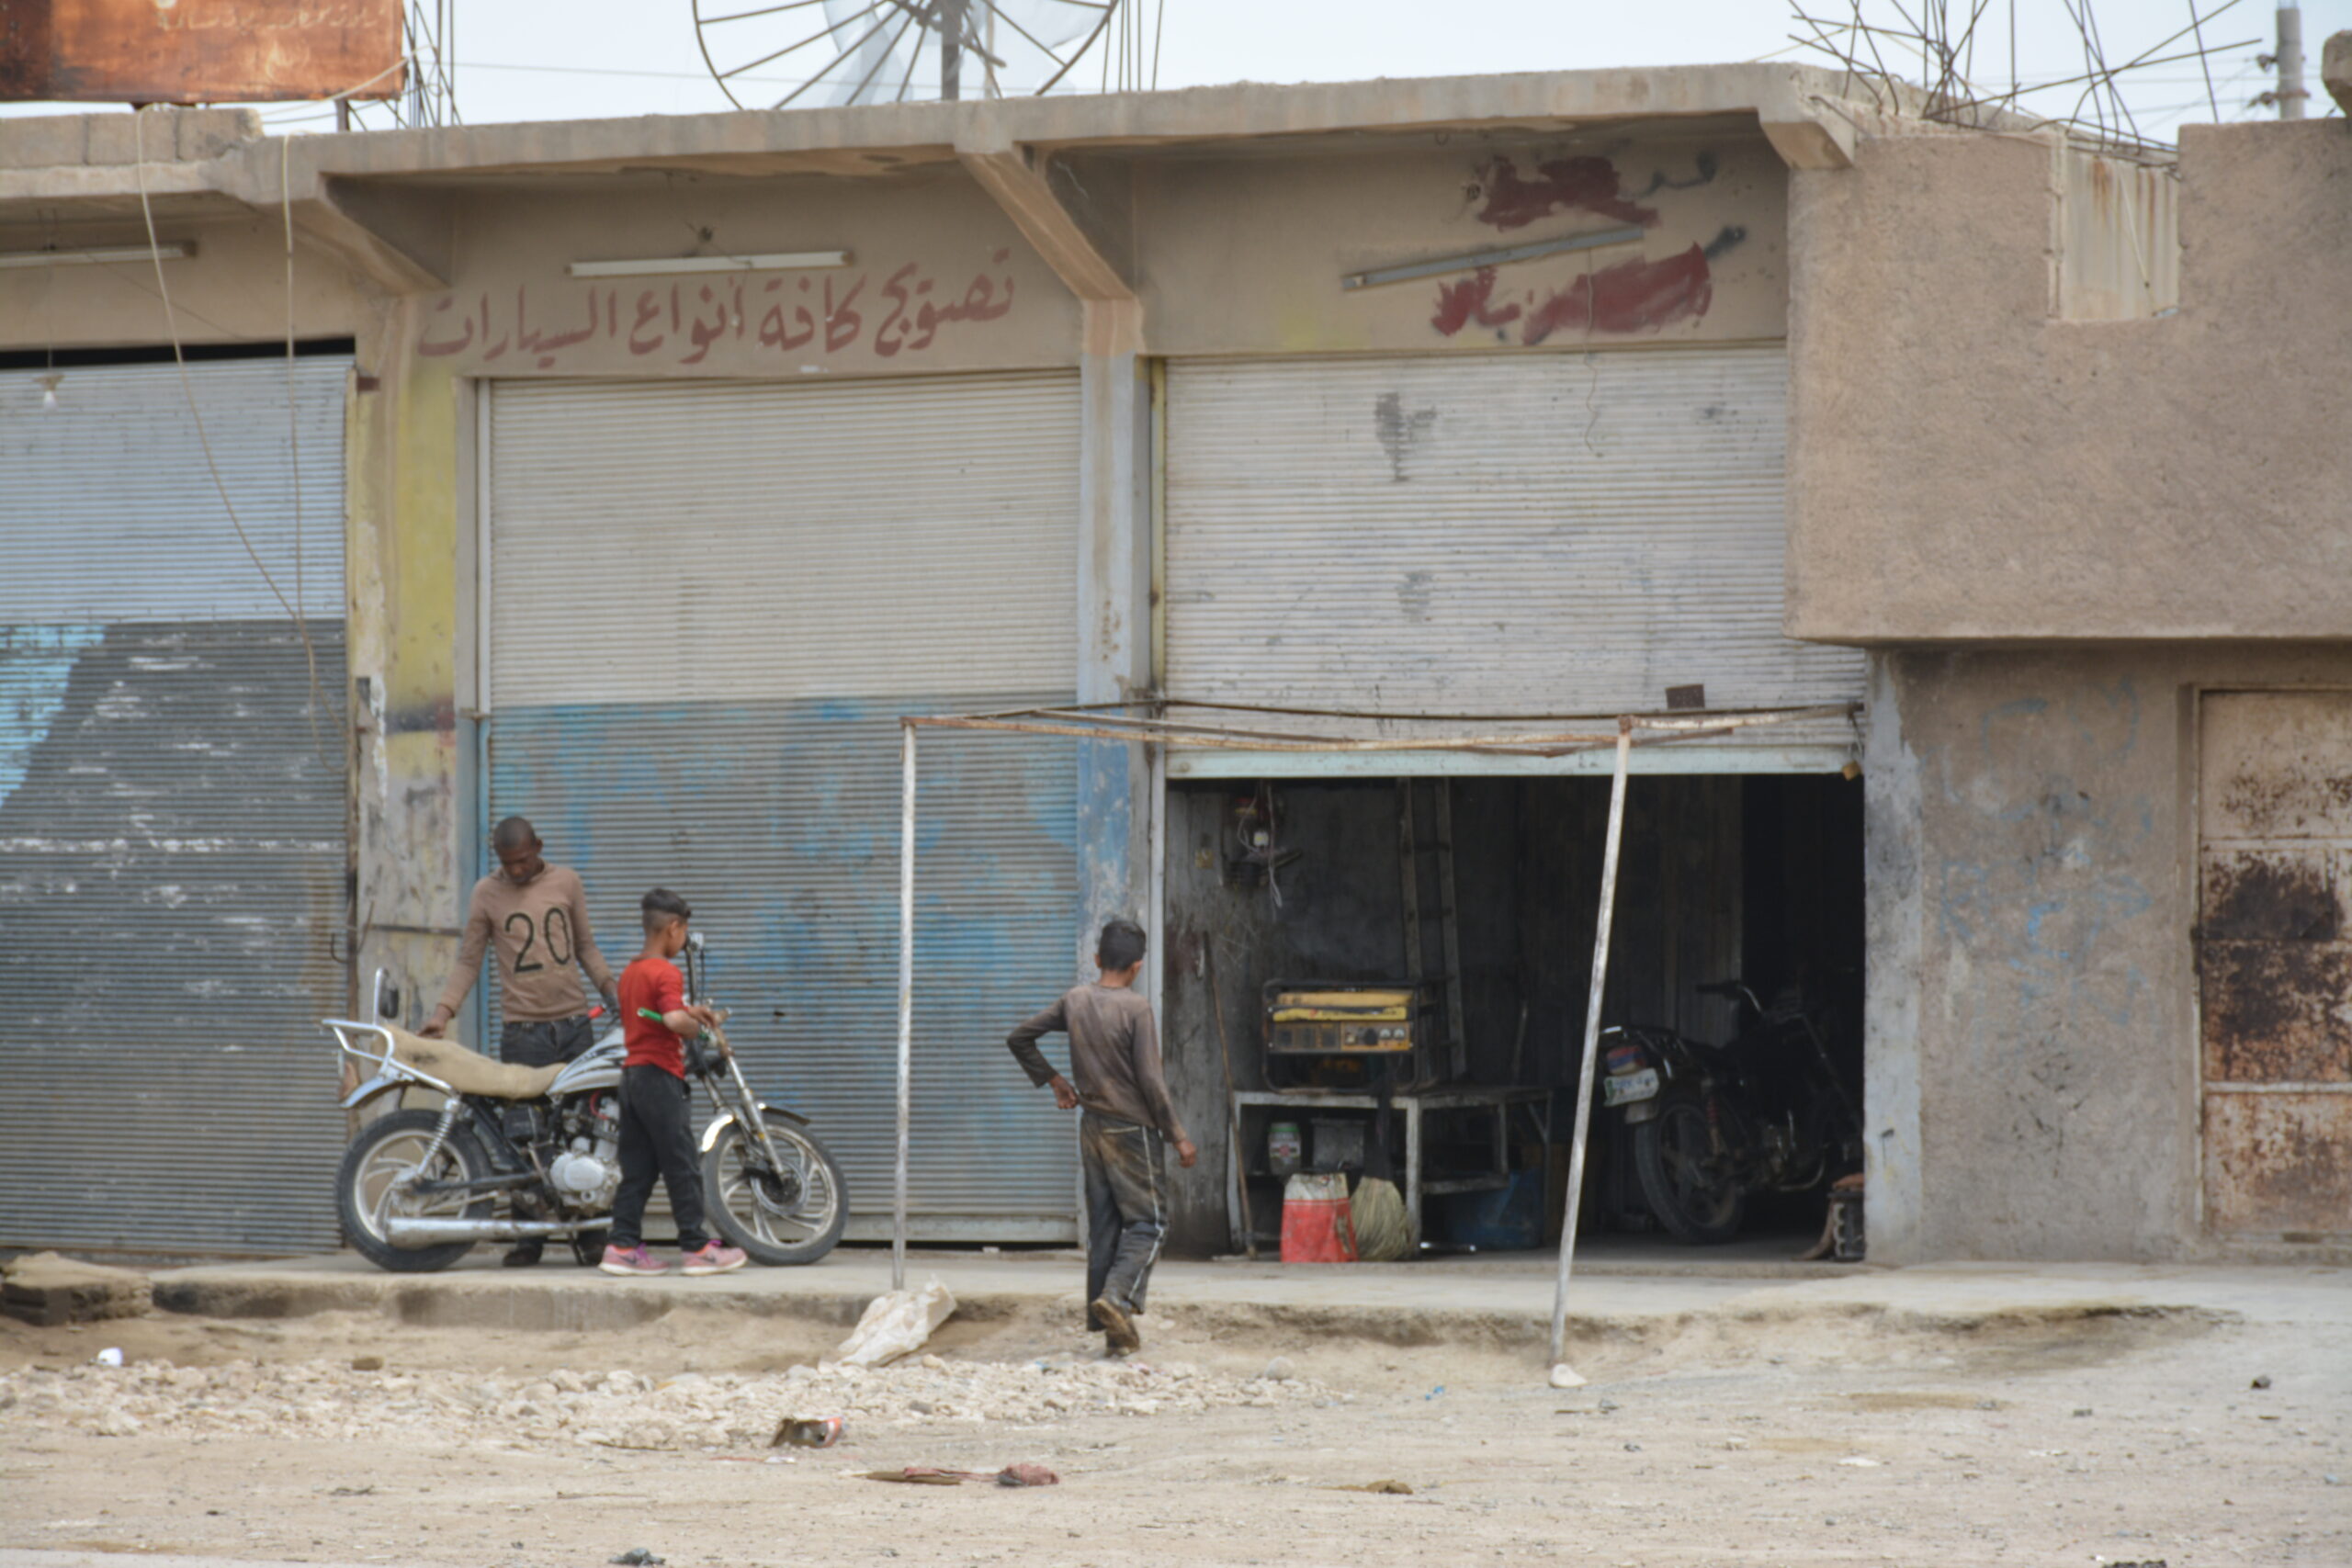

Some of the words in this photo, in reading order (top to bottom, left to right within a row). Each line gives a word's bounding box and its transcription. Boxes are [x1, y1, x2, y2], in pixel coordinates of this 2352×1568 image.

[416, 284, 617, 369] السيارات
[758, 276, 866, 354] كافة
[504, 908, 571, 973] 20
